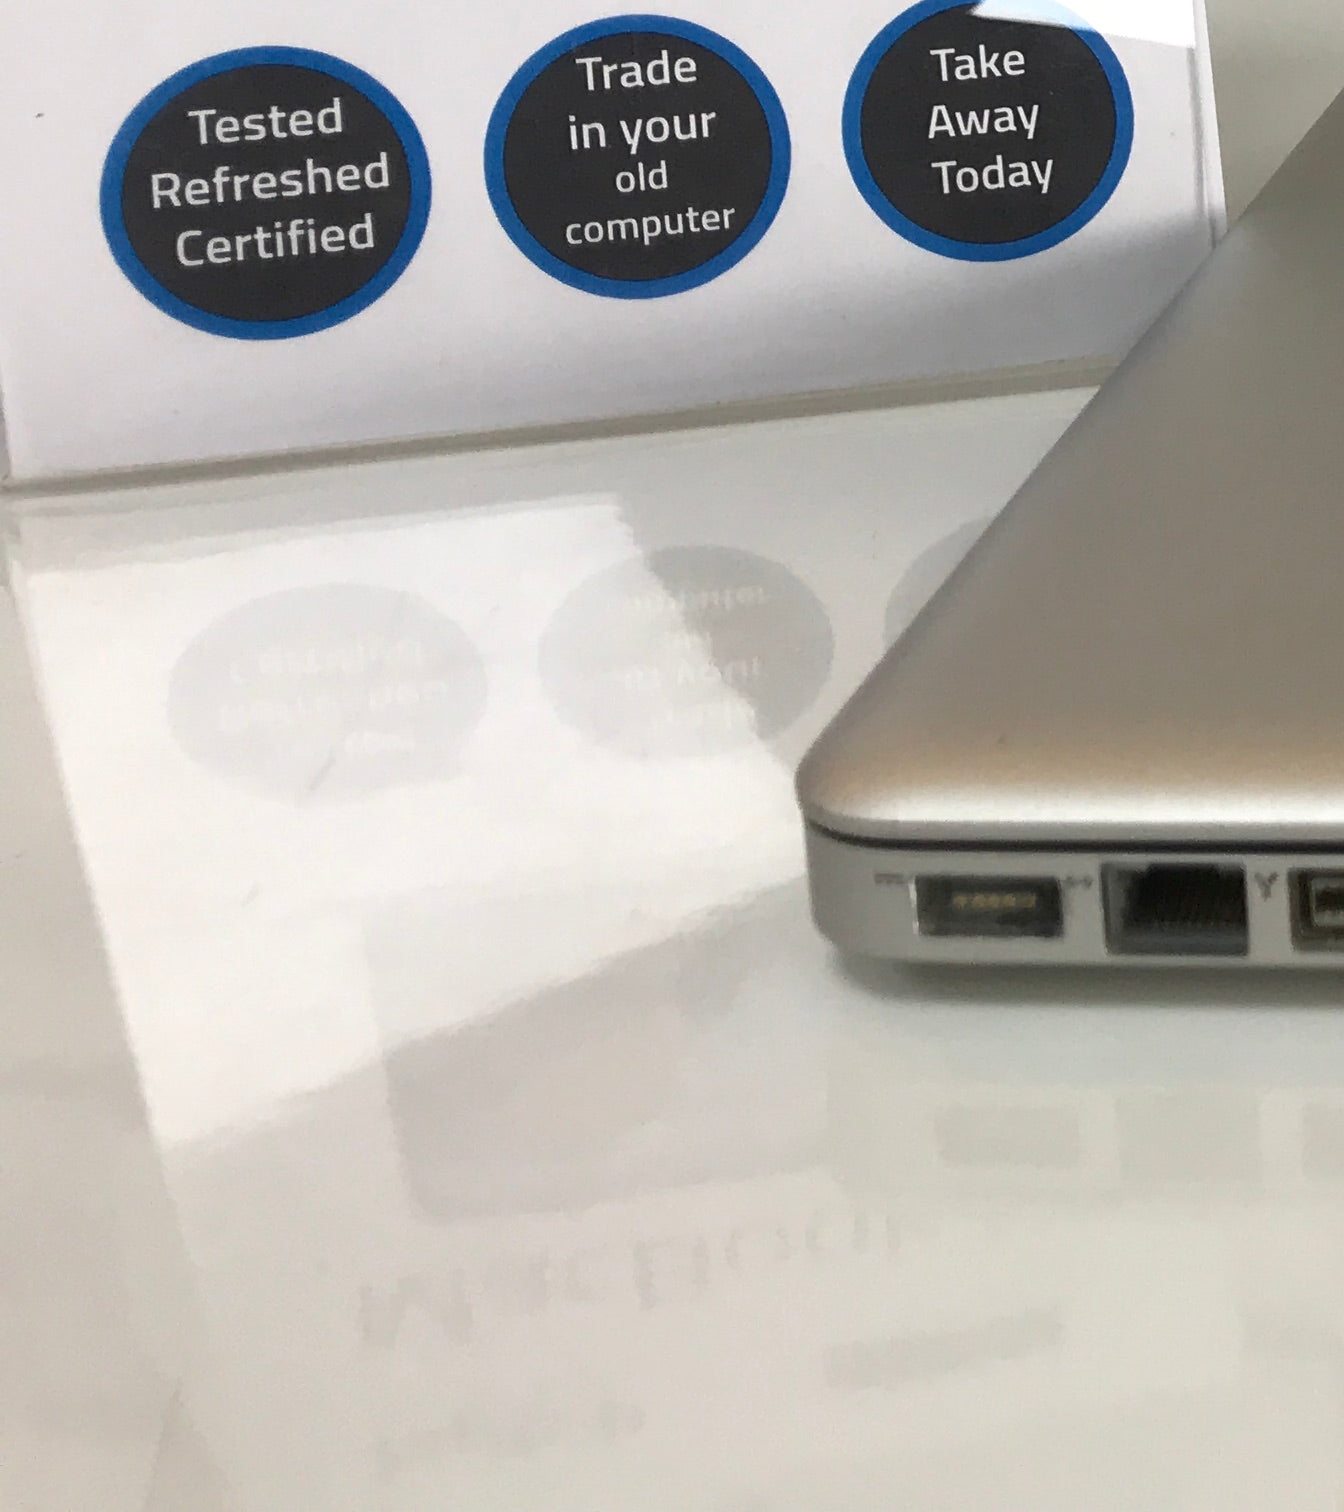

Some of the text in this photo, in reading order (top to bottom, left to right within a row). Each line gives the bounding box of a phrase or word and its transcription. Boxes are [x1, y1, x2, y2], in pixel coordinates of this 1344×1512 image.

[576, 50, 696, 90] Trade
[930, 45, 1025, 81] Take
[188, 97, 342, 144] Tested
[569, 112, 716, 154] in your
[929, 105, 1038, 139] Away
[152, 152, 389, 209] Refreshed
[616, 160, 667, 192] old
[931, 155, 1053, 193] Today
[177, 214, 374, 266] Certified
[566, 207, 735, 245] computer
